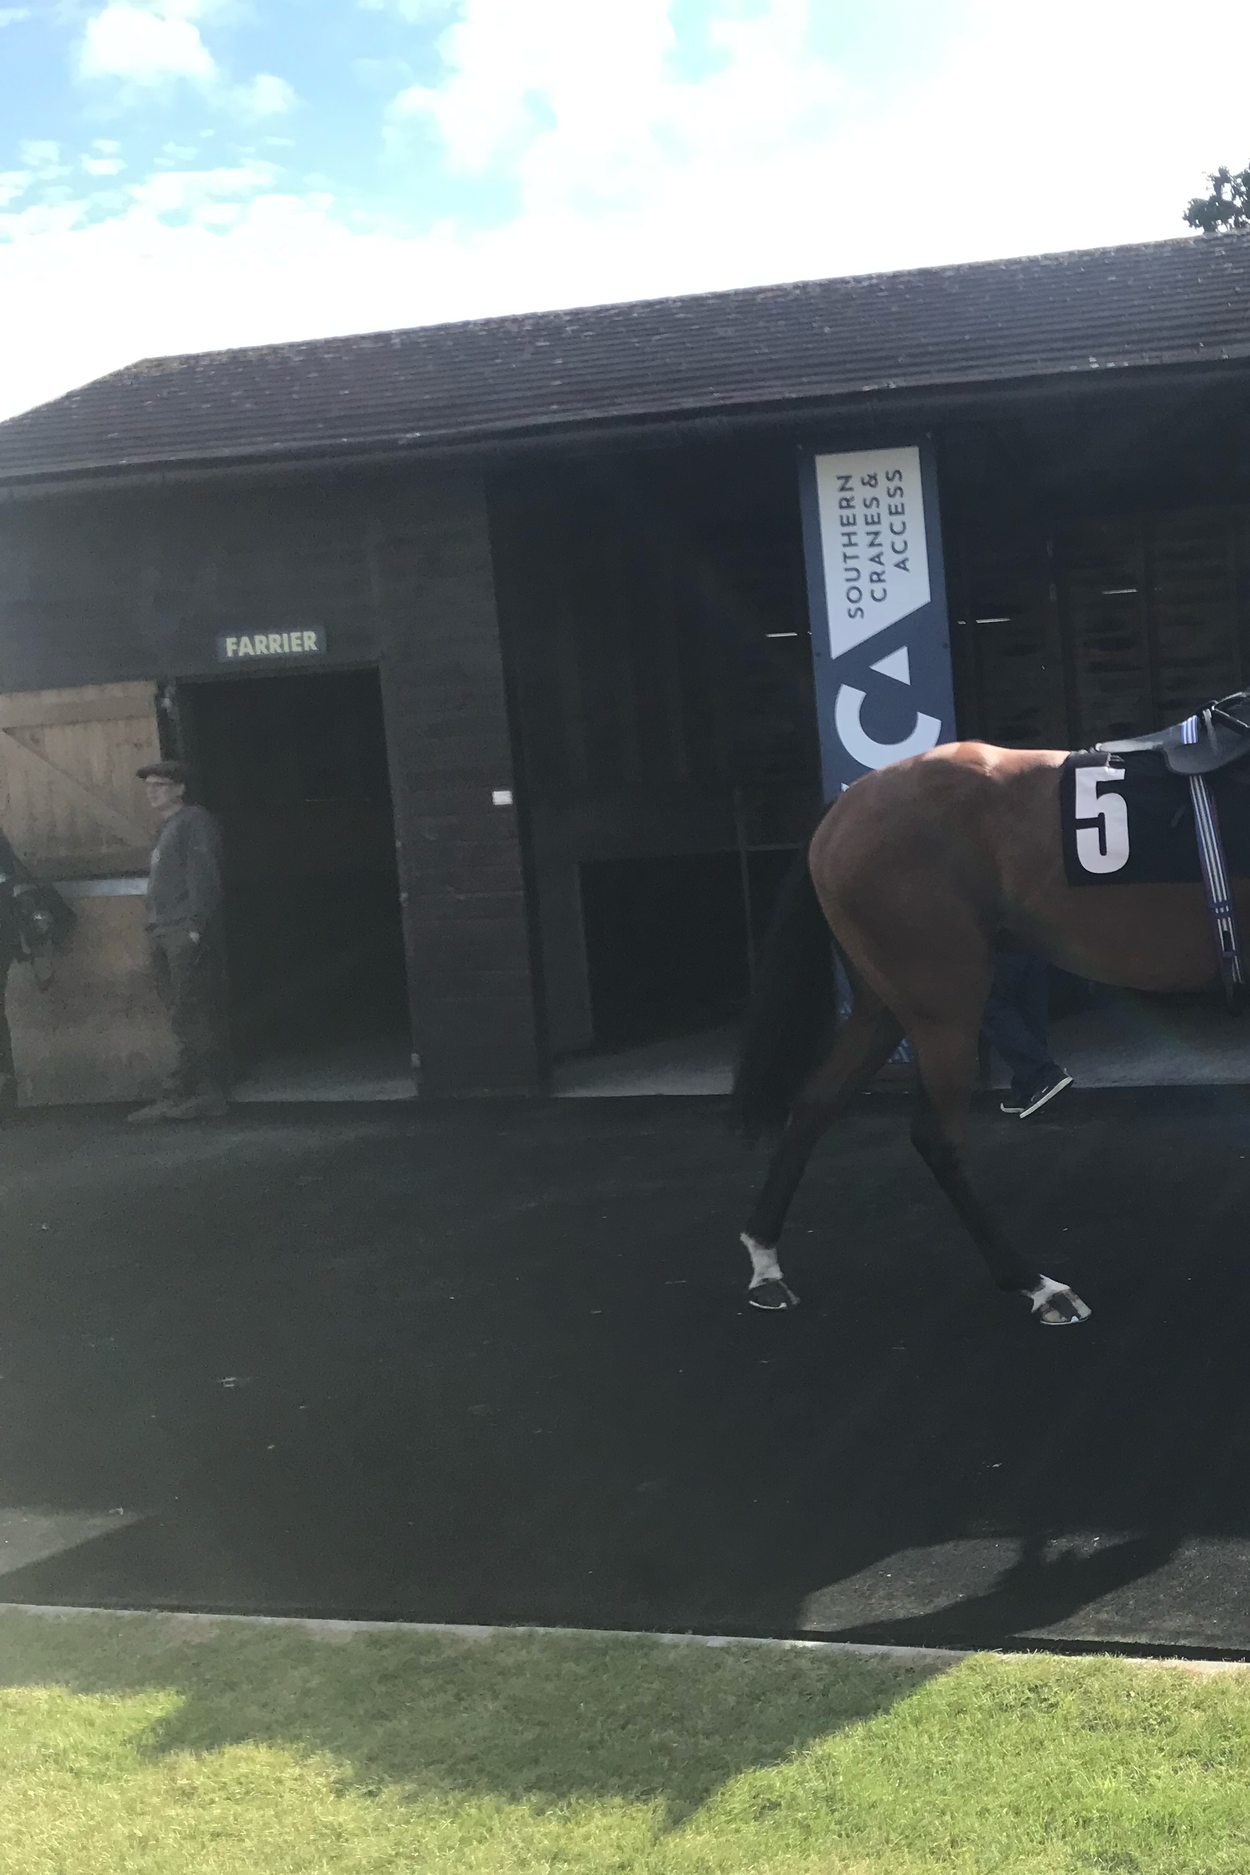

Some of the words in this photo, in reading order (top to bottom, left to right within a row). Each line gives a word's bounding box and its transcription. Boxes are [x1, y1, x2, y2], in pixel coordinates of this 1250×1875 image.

[860, 472, 880, 489] &
[885, 468, 910, 573] ACCESS
[836, 474, 864, 620] SOUTHERN
[863, 496, 888, 603] CRANES
[225, 630, 318, 658] FARRIER
[1075, 766, 1130, 874] 5
